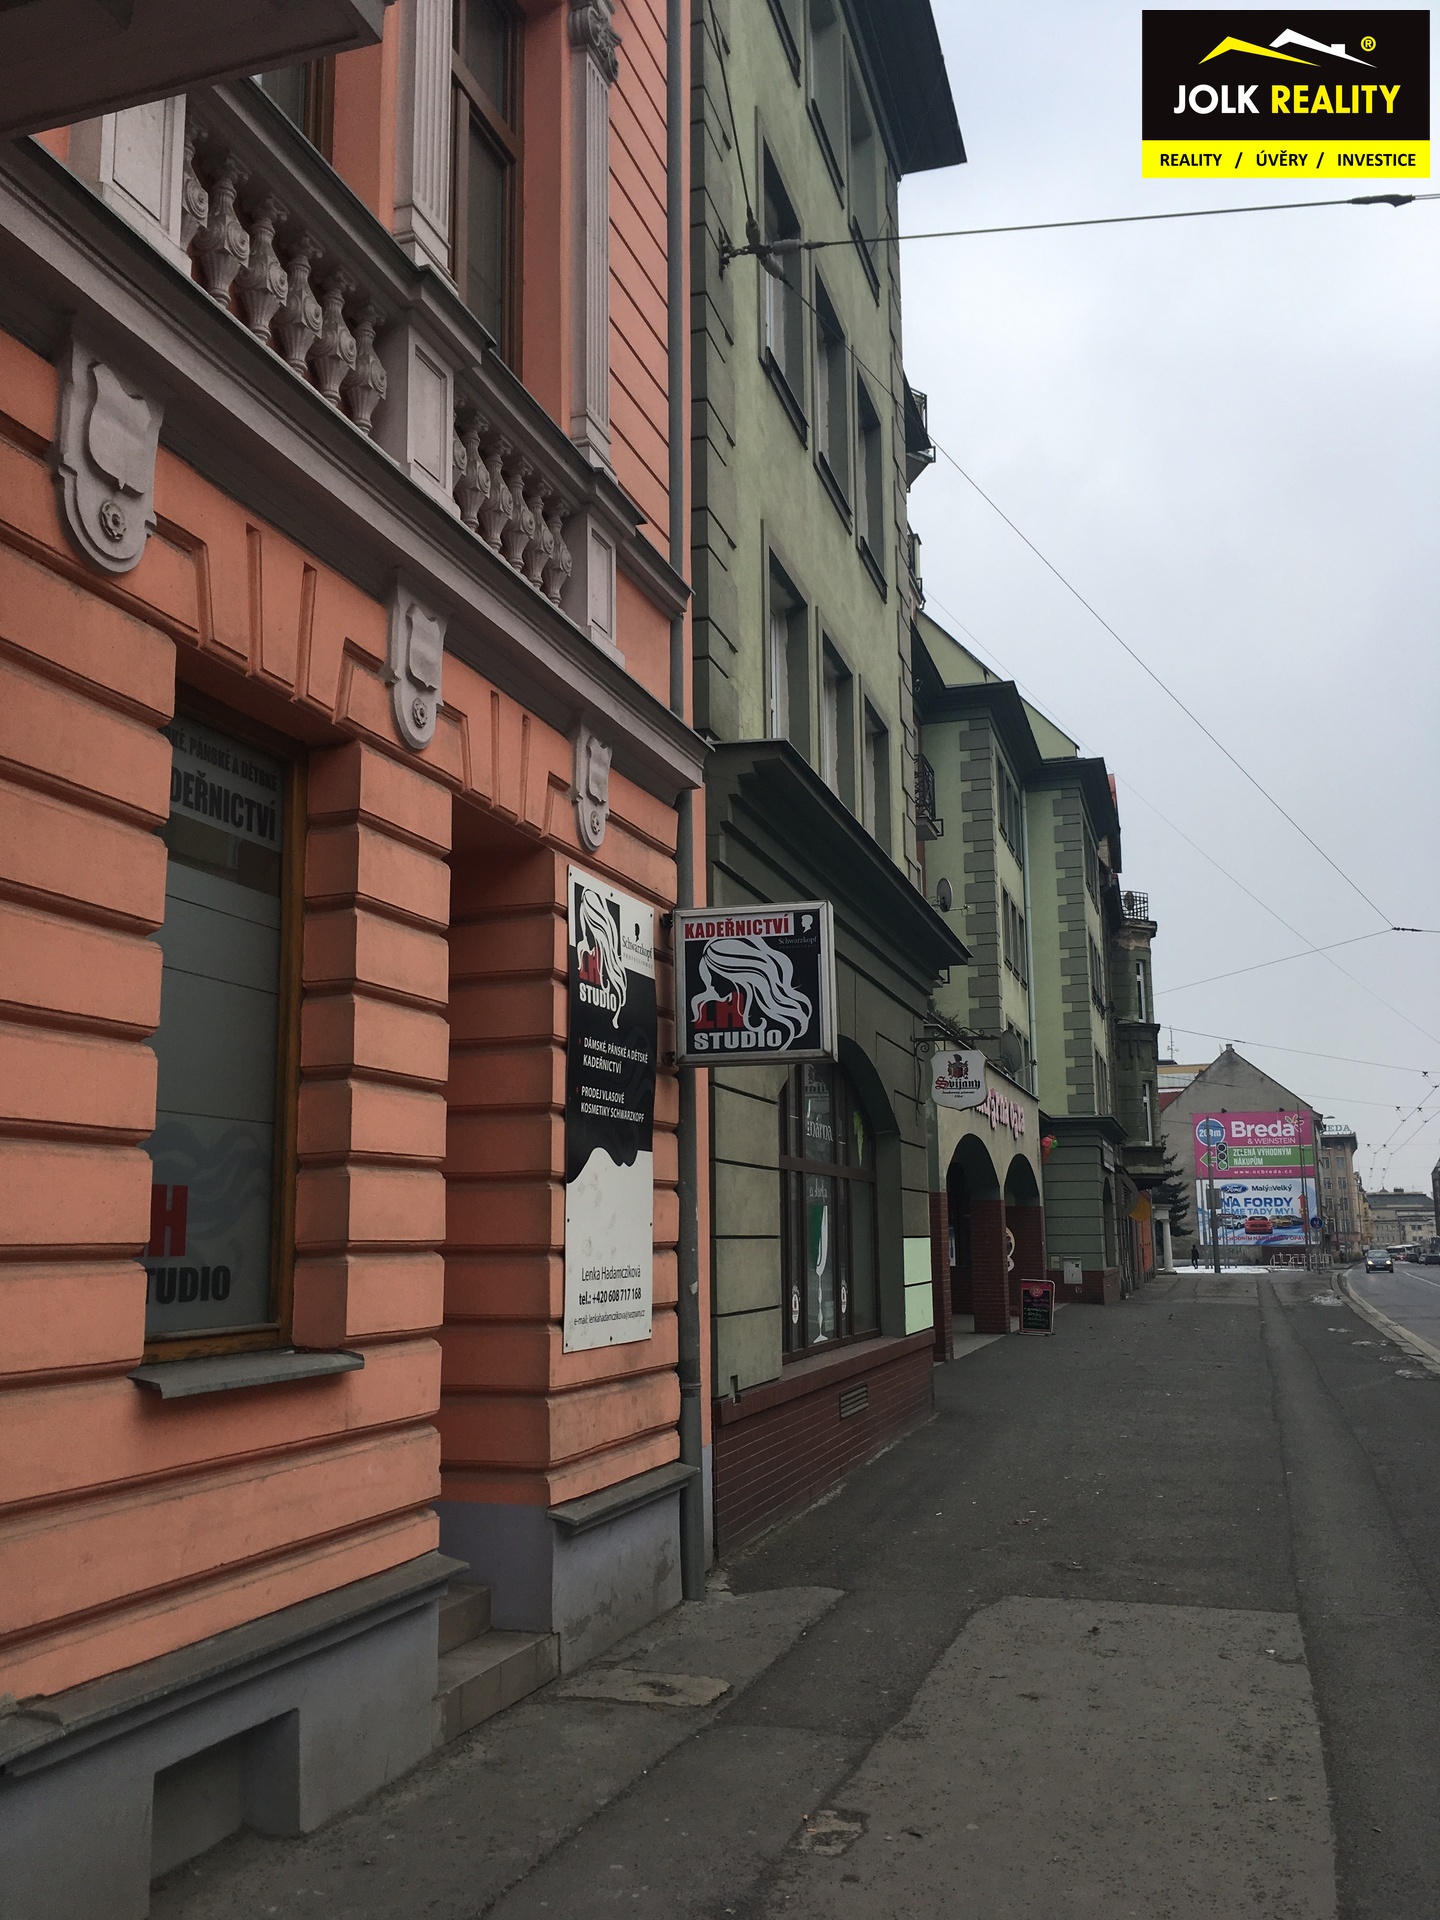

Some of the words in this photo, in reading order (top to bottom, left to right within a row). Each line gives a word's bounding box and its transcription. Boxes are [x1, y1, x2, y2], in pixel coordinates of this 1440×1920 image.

[684, 914, 789, 939] KADEŘNICTVÍ
[778, 936, 817, 946] Schwarzkopf
[579, 982, 616, 1012] STUDIO
[694, 1029, 782, 1050] STUDIO
[584, 1037, 607, 1053] DÁMSKÉ,
[607, 1043, 627, 1058] PÁNSKÉ
[627, 1050, 631, 1058] A
[631, 1049, 648, 1063] DĚTSKÉ
[583, 1054, 622, 1074] KADEŘNICTVÍ
[935, 1076, 981, 1089] Svijany
[581, 1086, 601, 1099] PRODEJ
[602, 1091, 625, 1104] VLASOVÉ
[581, 1102, 610, 1115] KOSMETIKY
[610, 1107, 645, 1122] SCHWARZKOPF
[1231, 1121, 1295, 1138] Breda
[1257, 1147, 1292, 1156] VÝHODNÝM
[1234, 1156, 1264, 1166] NÁKUPŮM
[1244, 1197, 1293, 1207] FORDY
[582, 1267, 600, 1281] Lenka
[592, 1291, 607, 1303] +420
[608, 1290, 619, 1302] 608
[620, 1289, 631, 1301] 717
[632, 1288, 641, 1300] 168
